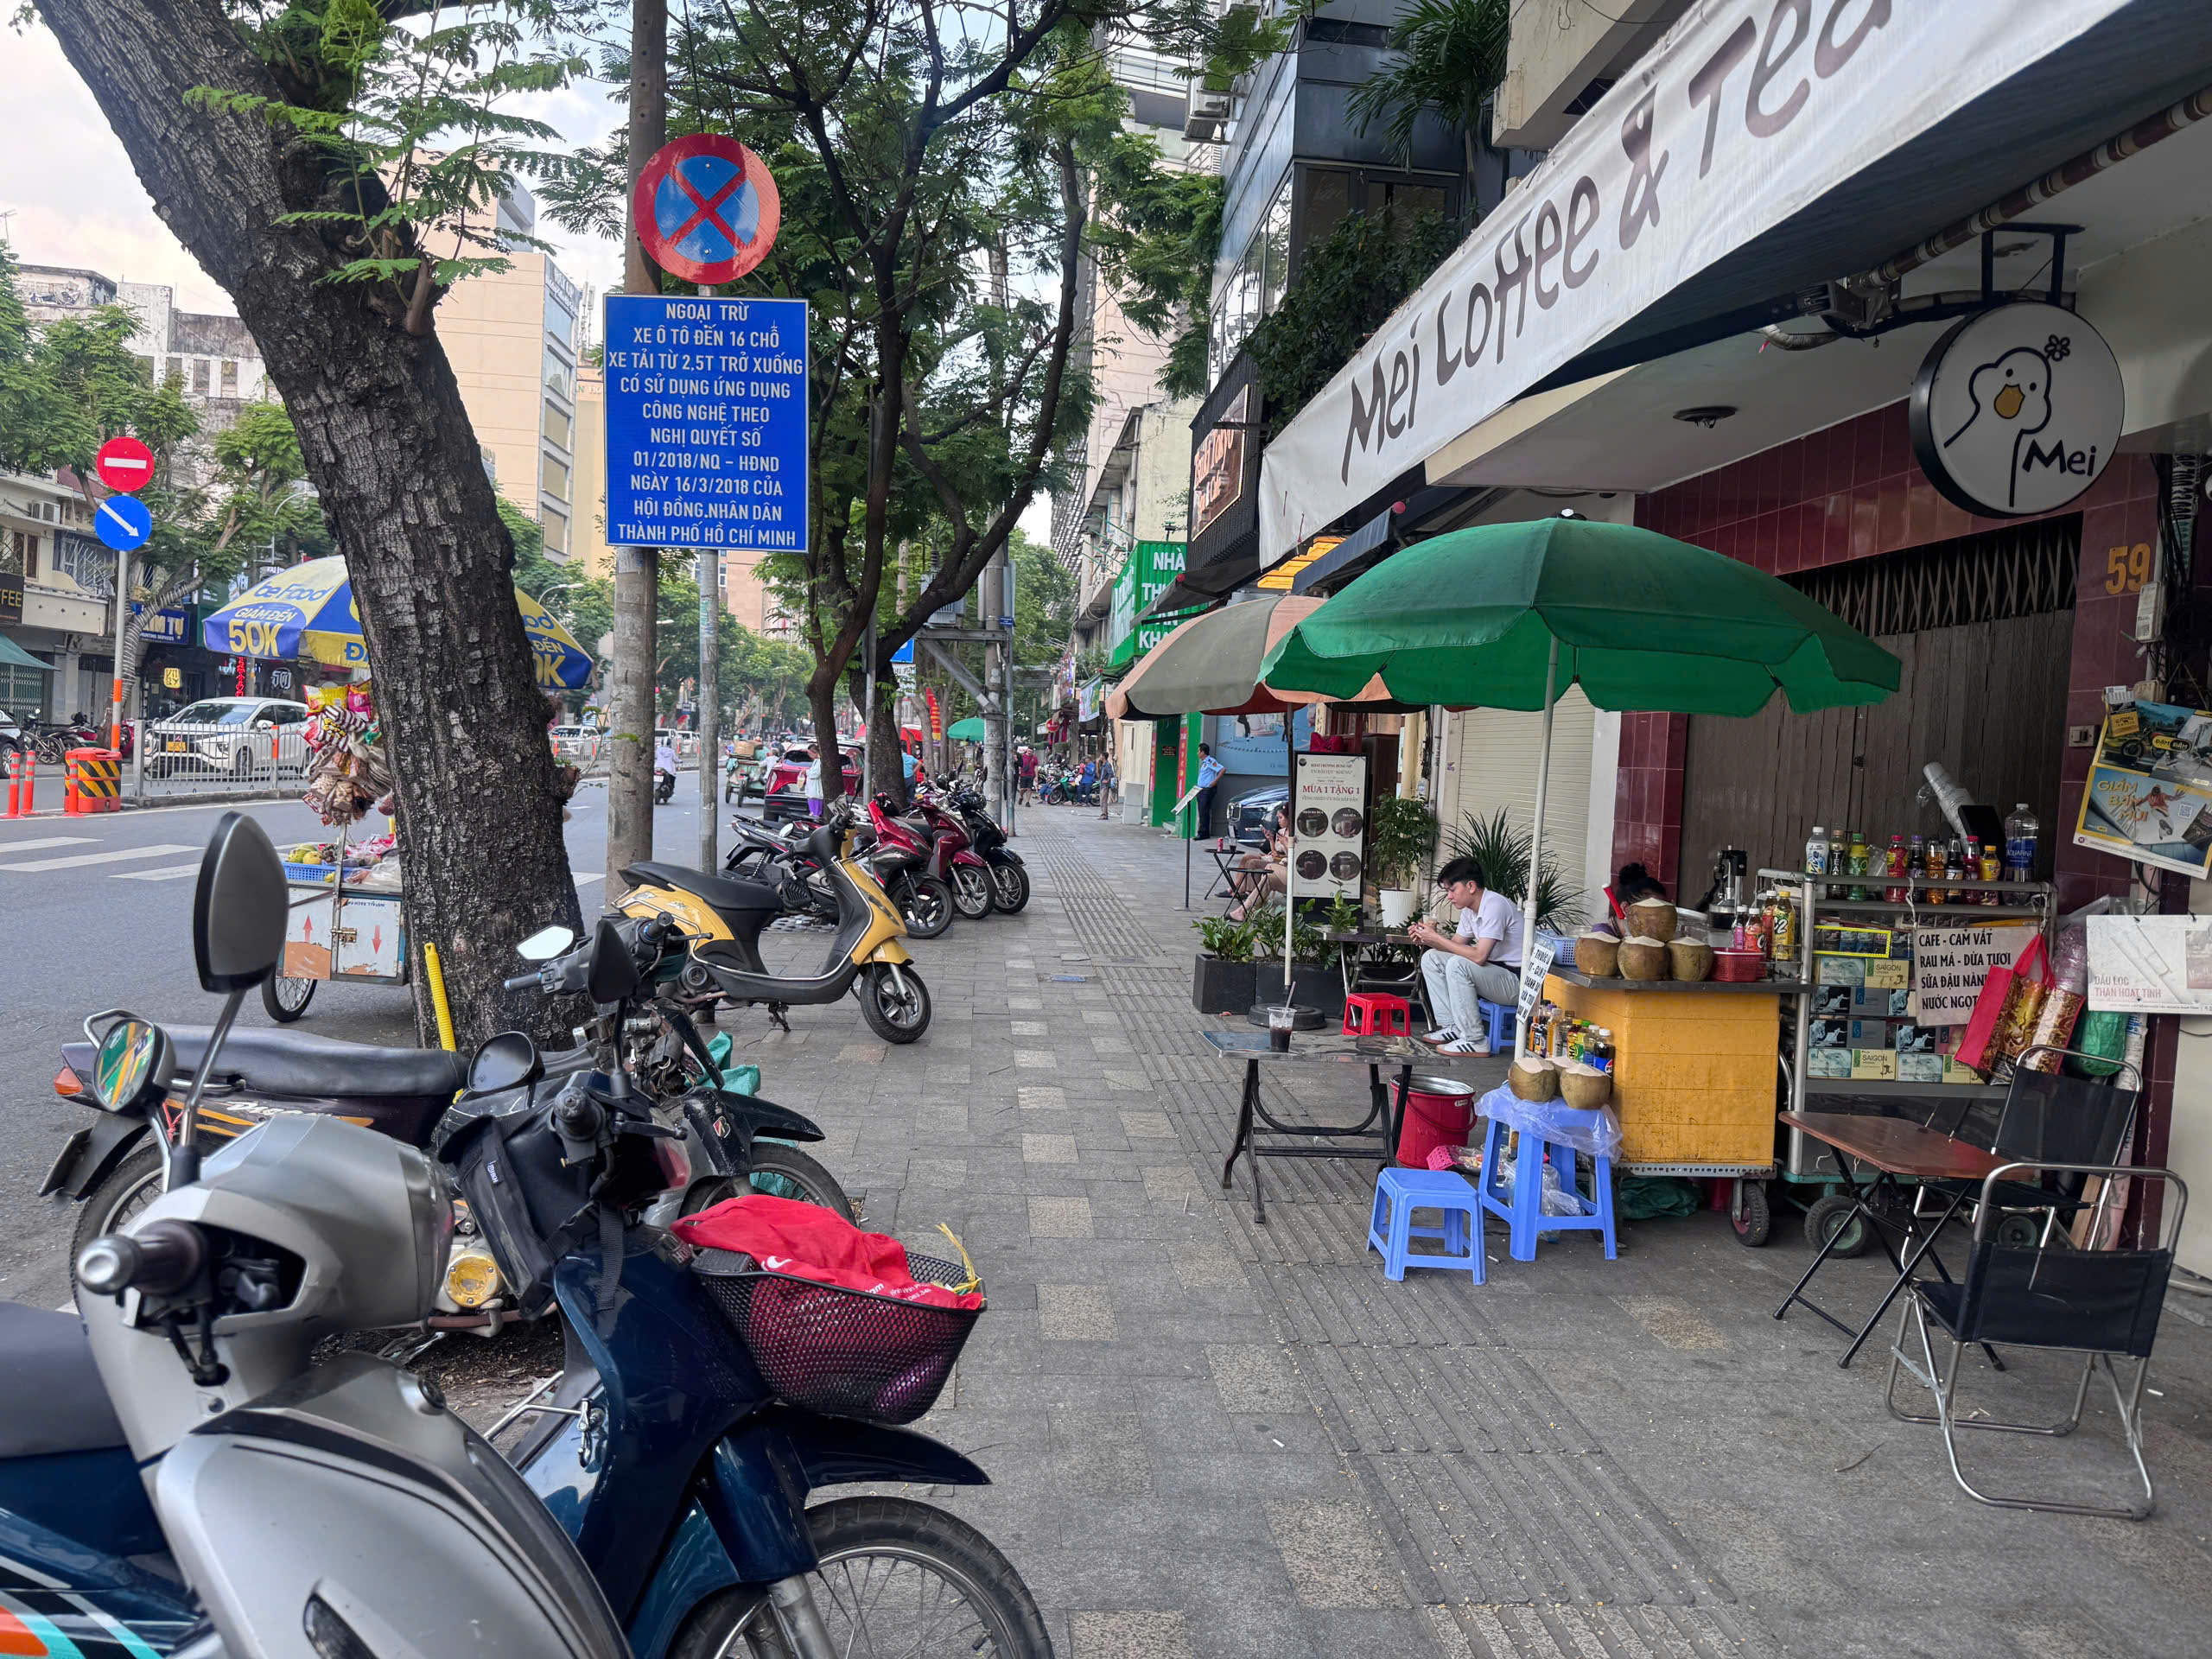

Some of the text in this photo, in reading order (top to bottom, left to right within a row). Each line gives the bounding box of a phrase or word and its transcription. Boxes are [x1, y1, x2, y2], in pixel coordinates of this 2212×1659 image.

[1342, 0, 1892, 486] Mei Coffee & Tea
[666, 302, 750, 323] NGOẠI TRỪ
[633, 324, 779, 347] XE Ô TÔ ĐẾN 16 CHỖ
[609, 352, 626, 367] XE
[632, 348, 653, 368] TẢI
[658, 349, 678, 370] TỪ
[720, 352, 748, 372] TRỞ
[753, 352, 803, 374] XUỐNG
[620, 372, 790, 401] CÓ SỬ DỤNG ỨNG DỤNG
[643, 400, 770, 423] CÔNG NGHỆ THEO
[651, 424, 764, 448] NGHỊ QUYẾT SỐ
[633, 451, 721, 470] 01/2018/NQ
[739, 455, 779, 472] HĐND
[2022, 439, 2096, 476] Mei
[631, 471, 783, 496] NGÀY 16/3/2018 CỦA
[634, 495, 782, 521] HỘI ĐỒNG NHÂN DÂN
[618, 520, 796, 546] THÀNH PHỐ HỒ CHÍ MINH
[1154, 548, 1185, 571] NHÀ
[2105, 543, 2151, 594] 59
[0, 588, 22, 607] FEE
[255, 582, 282, 598] be
[276, 583, 334, 601] Food
[1141, 583, 1166, 602] TH
[229, 620, 283, 657] 50K
[1330, 785, 1354, 795] TẶNG
[2098, 779, 2138, 792] GIẢM
[1919, 934, 1940, 946] CAFE
[1949, 933, 1970, 945] CAM
[1920, 955, 1937, 968] RAU
[1941, 951, 1955, 967] MÁ
[1964, 951, 1984, 966] DỪA
[1922, 973, 1938, 988] SỮA
[1941, 972, 1960, 990] ĐẬU
[1922, 994, 1978, 1010] NƯỚC NGỌT
